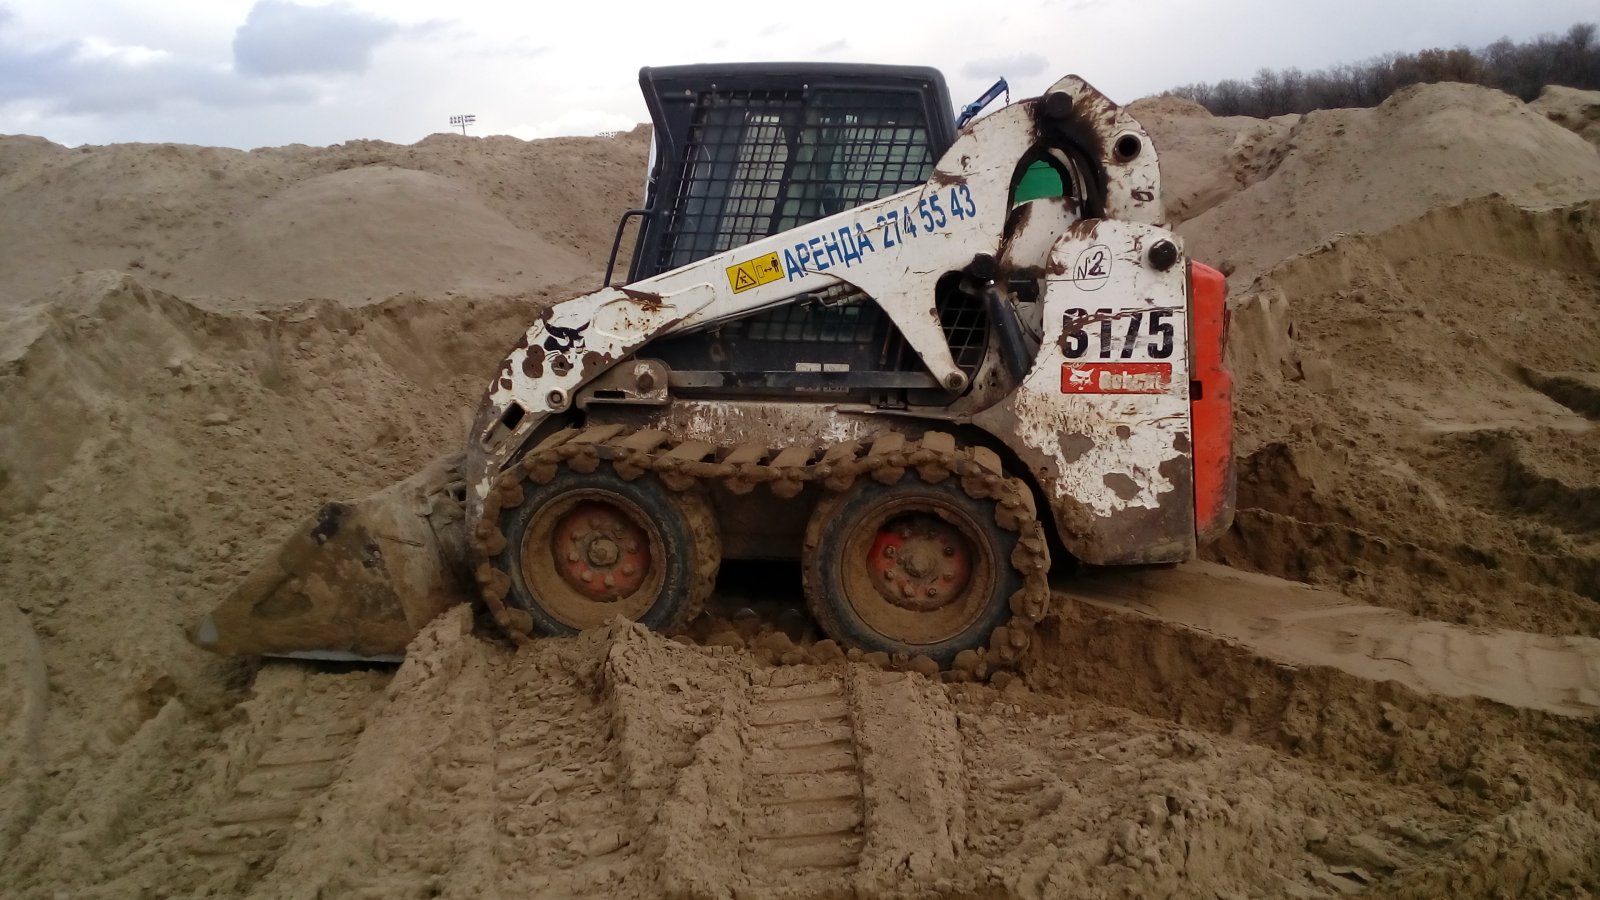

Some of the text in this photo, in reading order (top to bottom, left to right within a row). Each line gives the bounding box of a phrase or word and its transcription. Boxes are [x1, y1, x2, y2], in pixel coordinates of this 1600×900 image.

[785, 184, 977, 282] АРЕНДА 274 55 43
